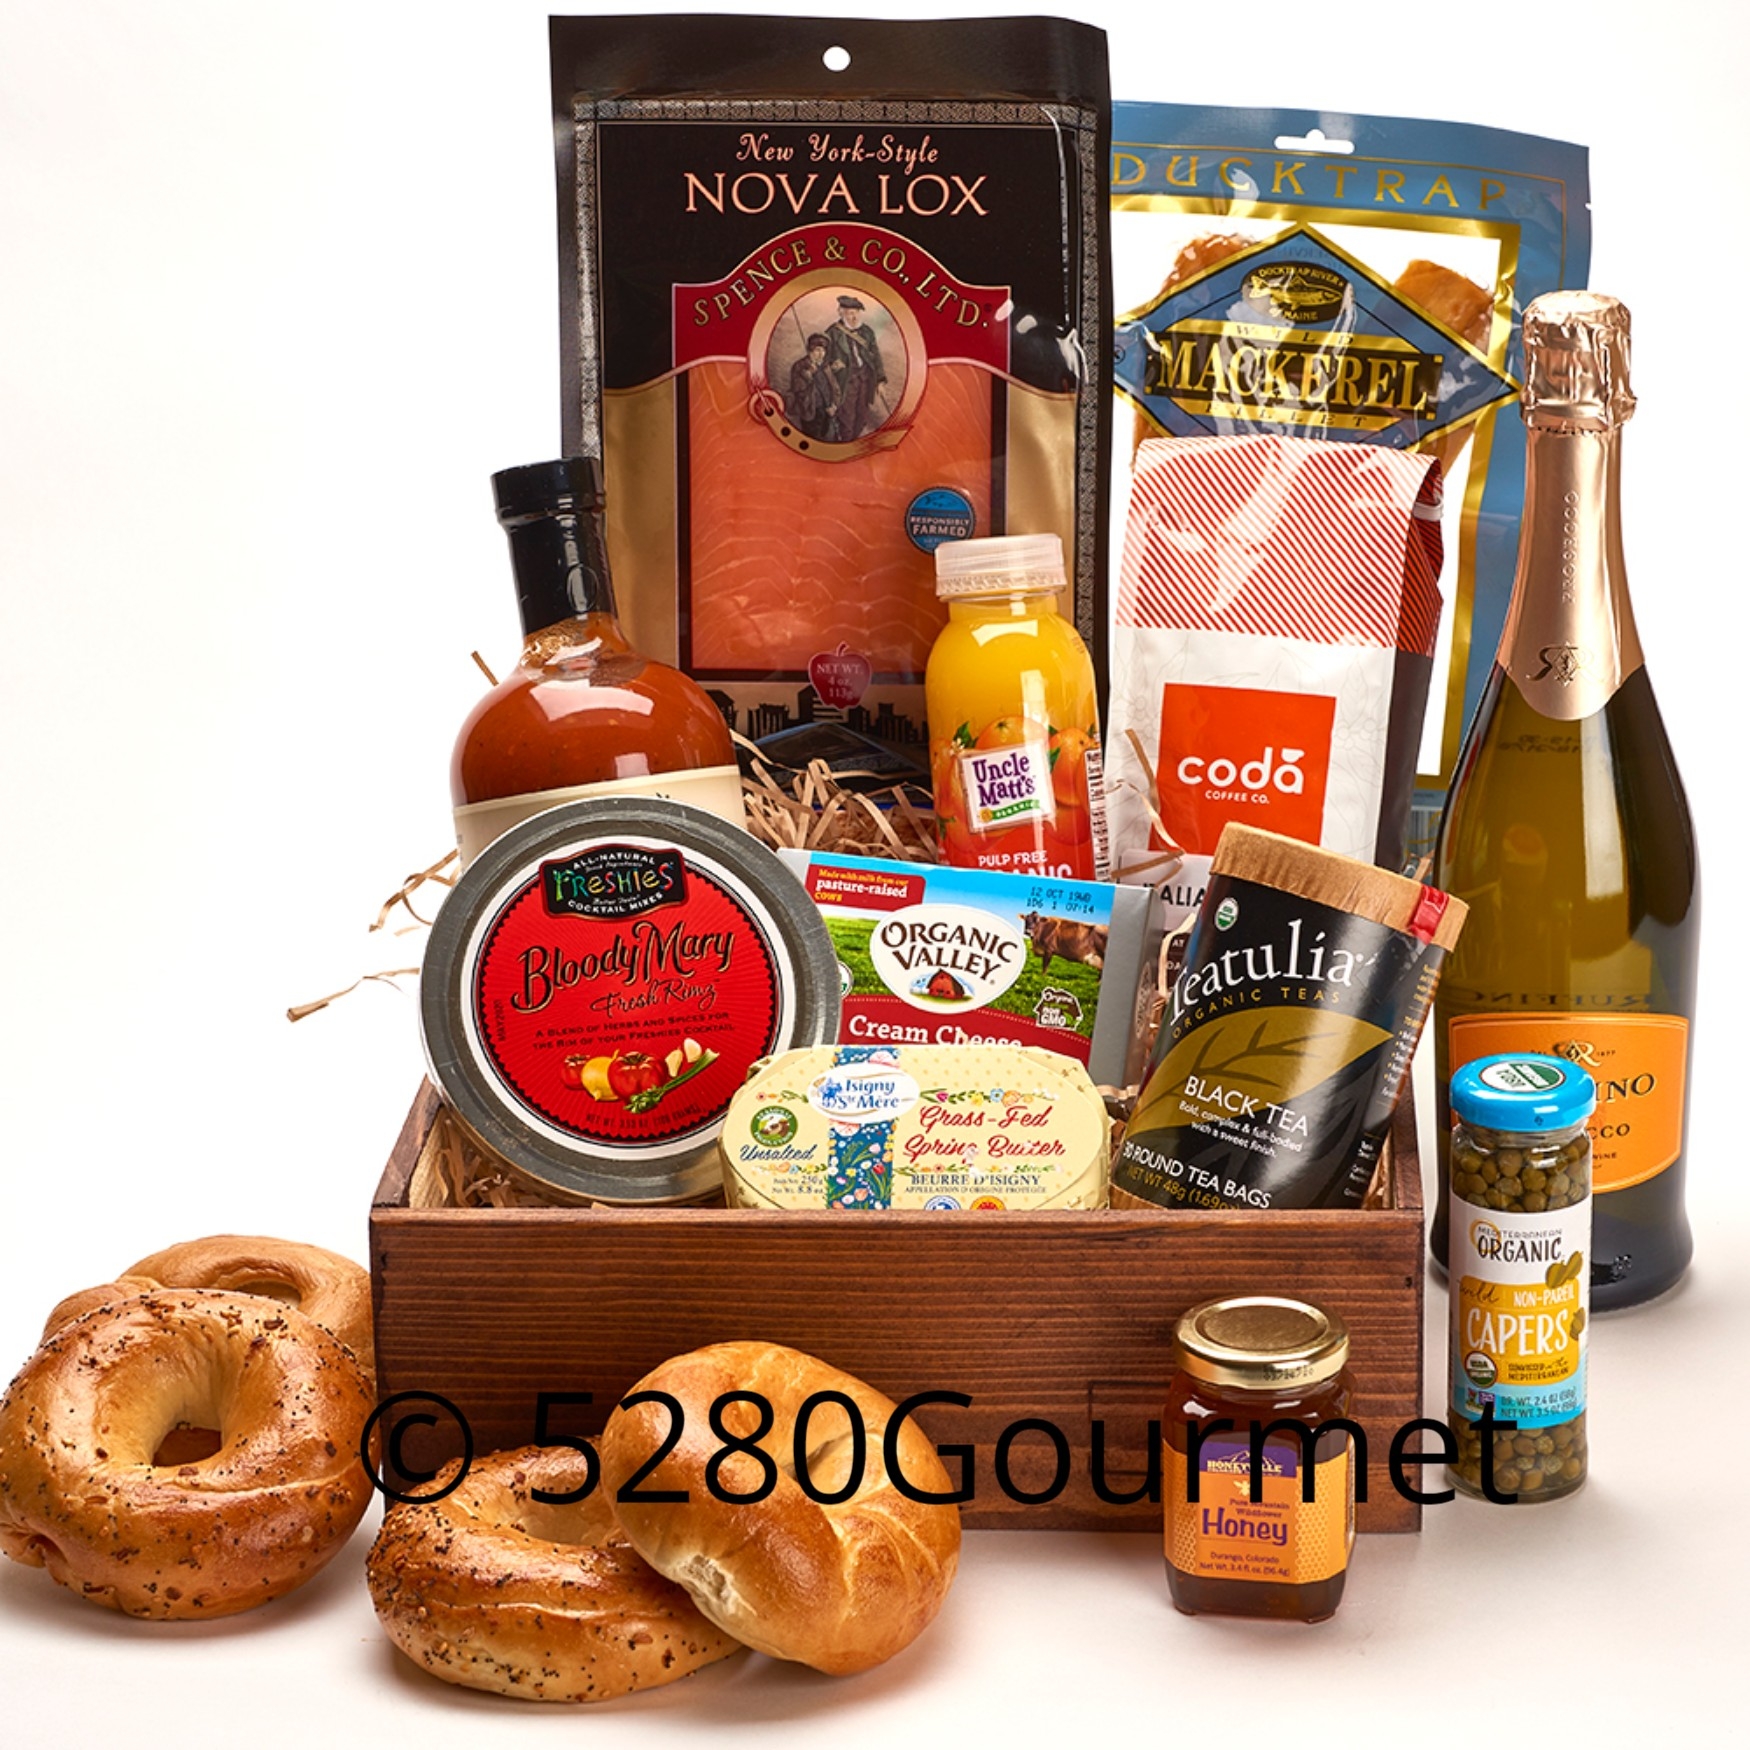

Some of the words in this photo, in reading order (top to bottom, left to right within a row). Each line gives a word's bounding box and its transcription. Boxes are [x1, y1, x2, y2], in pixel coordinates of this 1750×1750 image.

[736, 134, 794, 162] New
[808, 133, 940, 175] York-Style
[1111, 152, 1507, 211] DUCKTRAP
[684, 172, 861, 216] NOVA
[878, 174, 990, 217] LOX
[692, 238, 813, 328] SPENCE
[823, 236, 846, 262] &
[914, 271, 989, 328] LTD.
[1311, 269, 1340, 284] RIVER
[1283, 310, 1319, 320] MAINE
[1159, 339, 1429, 411] MACKEREL
[910, 515, 970, 526] RESPONSIBLY
[912, 525, 967, 538] FARMED
[1562, 489, 1579, 604] PROSECCO
[816, 663, 839, 675] NET
[827, 676, 836, 686] 4
[972, 752, 1030, 783] Uncle
[977, 776, 1036, 808] Matt's
[1205, 790, 1248, 803] COFFEE
[1250, 792, 1270, 804] CO.
[573, 851, 656, 870] ALL-NATURAL
[978, 854, 1011, 867] PULP
[1013, 850, 1049, 866] FREE
[816, 879, 908, 899] pasture-raised
[1046, 888, 1065, 899] OCT
[567, 899, 626, 914] COCKTAIL
[629, 891, 664, 911] MIXES
[881, 920, 1019, 964] ORGANIC
[510, 933, 641, 1015] Bloody
[632, 920, 736, 984] Mary
[892, 944, 1003, 982] VALLEY
[589, 977, 662, 1018] Fresh
[535, 1029, 543, 1037] A
[586, 1024, 600, 1033] OF
[643, 1018, 665, 1027] AND
[708, 1011, 730, 1021] FOR
[1041, 1013, 1067, 1027] GMO
[1171, 988, 1263, 1039] ORGANIC
[1279, 986, 1340, 1004] TEAS
[532, 1042, 553, 1050] THE
[580, 1037, 594, 1046] OF
[597, 1033, 627, 1043] YOUR
[849, 1015, 929, 1045] Cream
[935, 1024, 1023, 1047] Cheese
[846, 1079, 896, 1096] Isigny
[1183, 1075, 1260, 1119] BLACK
[1265, 1101, 1309, 1137] TEA
[1179, 1100, 1200, 1117] Bold,
[1201, 1109, 1241, 1132] complex
[1241, 1122, 1252, 1134] &
[1252, 1126, 1304, 1153] full-bodied
[739, 1143, 819, 1162] Unsalted
[986, 1134, 1067, 1158] Butter
[1190, 1120, 1212, 1136] with
[1212, 1130, 1219, 1138] a
[1219, 1132, 1251, 1150] sweet
[1250, 1140, 1278, 1160] finish.
[911, 1174, 970, 1186] BEURRE
[974, 1173, 1042, 1186] D'ISIGNY
[1127, 1165, 1145, 1182] NET
[1143, 1170, 1163, 1188] WT
[1162, 1179, 1188, 1201] 48g
[1132, 1144, 1185, 1178] ROUND
[1187, 1164, 1220, 1193] TEA
[1222, 1178, 1273, 1210] BAGS
[905, 1186, 960, 1194] APPELLATION
[1477, 1234, 1562, 1263] ORGANIC
[1513, 1283, 1576, 1308] NON-PAREIL
[1466, 1307, 1569, 1356] CAPERS
[1501, 1408, 1516, 1418] NET
[1536, 1407, 1550, 1418] 3.5
[1229, 1498, 1249, 1506] Pure
[1202, 1506, 1288, 1547] Honey
[1200, 1561, 1213, 1570] Net
[1210, 1551, 1244, 1563] Durango,
[1245, 1553, 1280, 1565] Colorado
